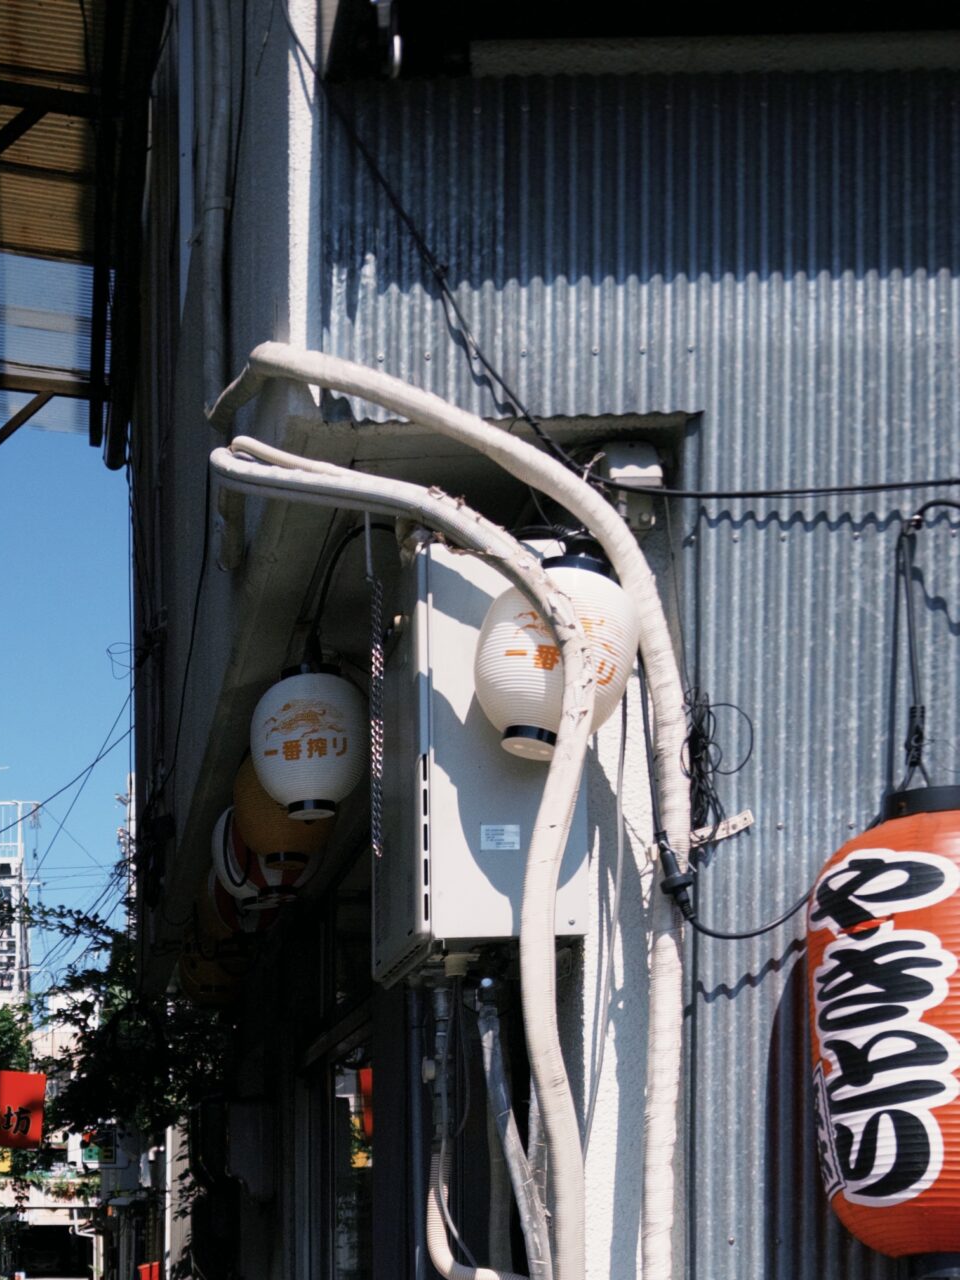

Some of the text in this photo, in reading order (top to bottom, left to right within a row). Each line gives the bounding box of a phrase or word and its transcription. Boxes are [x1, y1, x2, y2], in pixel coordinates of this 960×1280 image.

[504, 644, 618, 687] 一番り
[263, 736, 349, 761] 一番搾り
